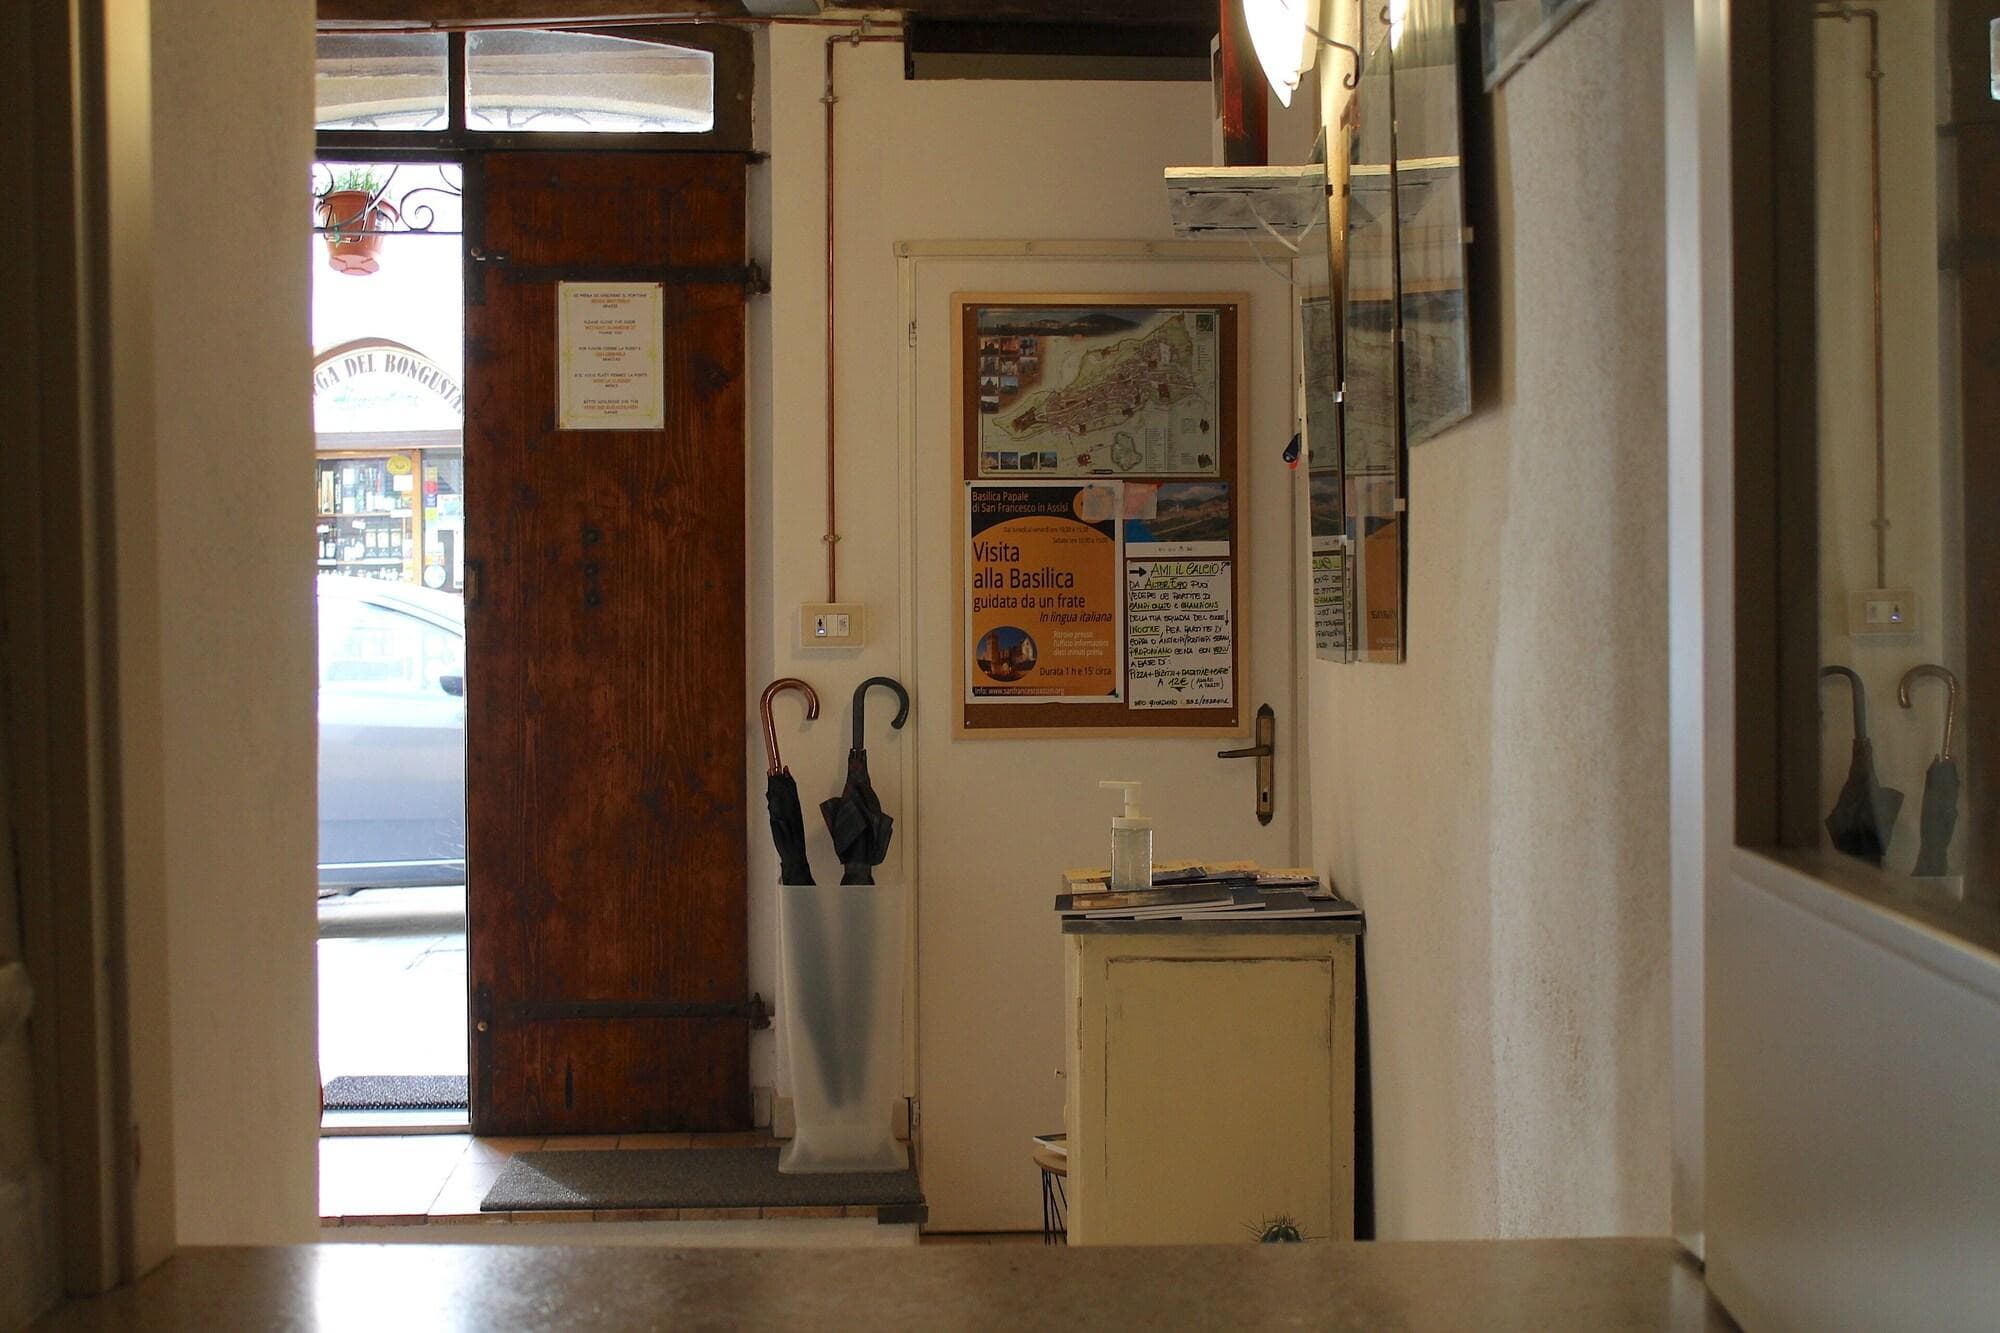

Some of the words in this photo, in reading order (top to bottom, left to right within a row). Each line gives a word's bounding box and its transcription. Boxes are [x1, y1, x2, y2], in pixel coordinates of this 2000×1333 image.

[314, 366, 340, 396] GA
[344, 353, 377, 377] DEL
[972, 491, 1001, 502] Basilica
[1002, 491, 1029, 504] Papale
[972, 503, 980, 513] di
[981, 503, 996, 513] San
[997, 503, 1037, 513] Francesco
[1037, 503, 1046, 512] in
[1047, 503, 1069, 513] Assisi
[973, 541, 1020, 562] Visita
[1151, 562, 1171, 576] AMI
[974, 567, 1004, 589] alla
[1010, 567, 1074, 589] Basilica
[1129, 580, 1140, 589] DA
[973, 593, 1017, 612] guidata
[1021, 593, 1035, 609] da
[1039, 597, 1054, 609] un
[1057, 593, 1086, 609] frate
[1050, 611, 1077, 625] lingua
[1080, 611, 1112, 622] italiana
[1040, 667, 1063, 676] Durata
[1071, 667, 1077, 676] h
[1095, 667, 1112, 676] circa
